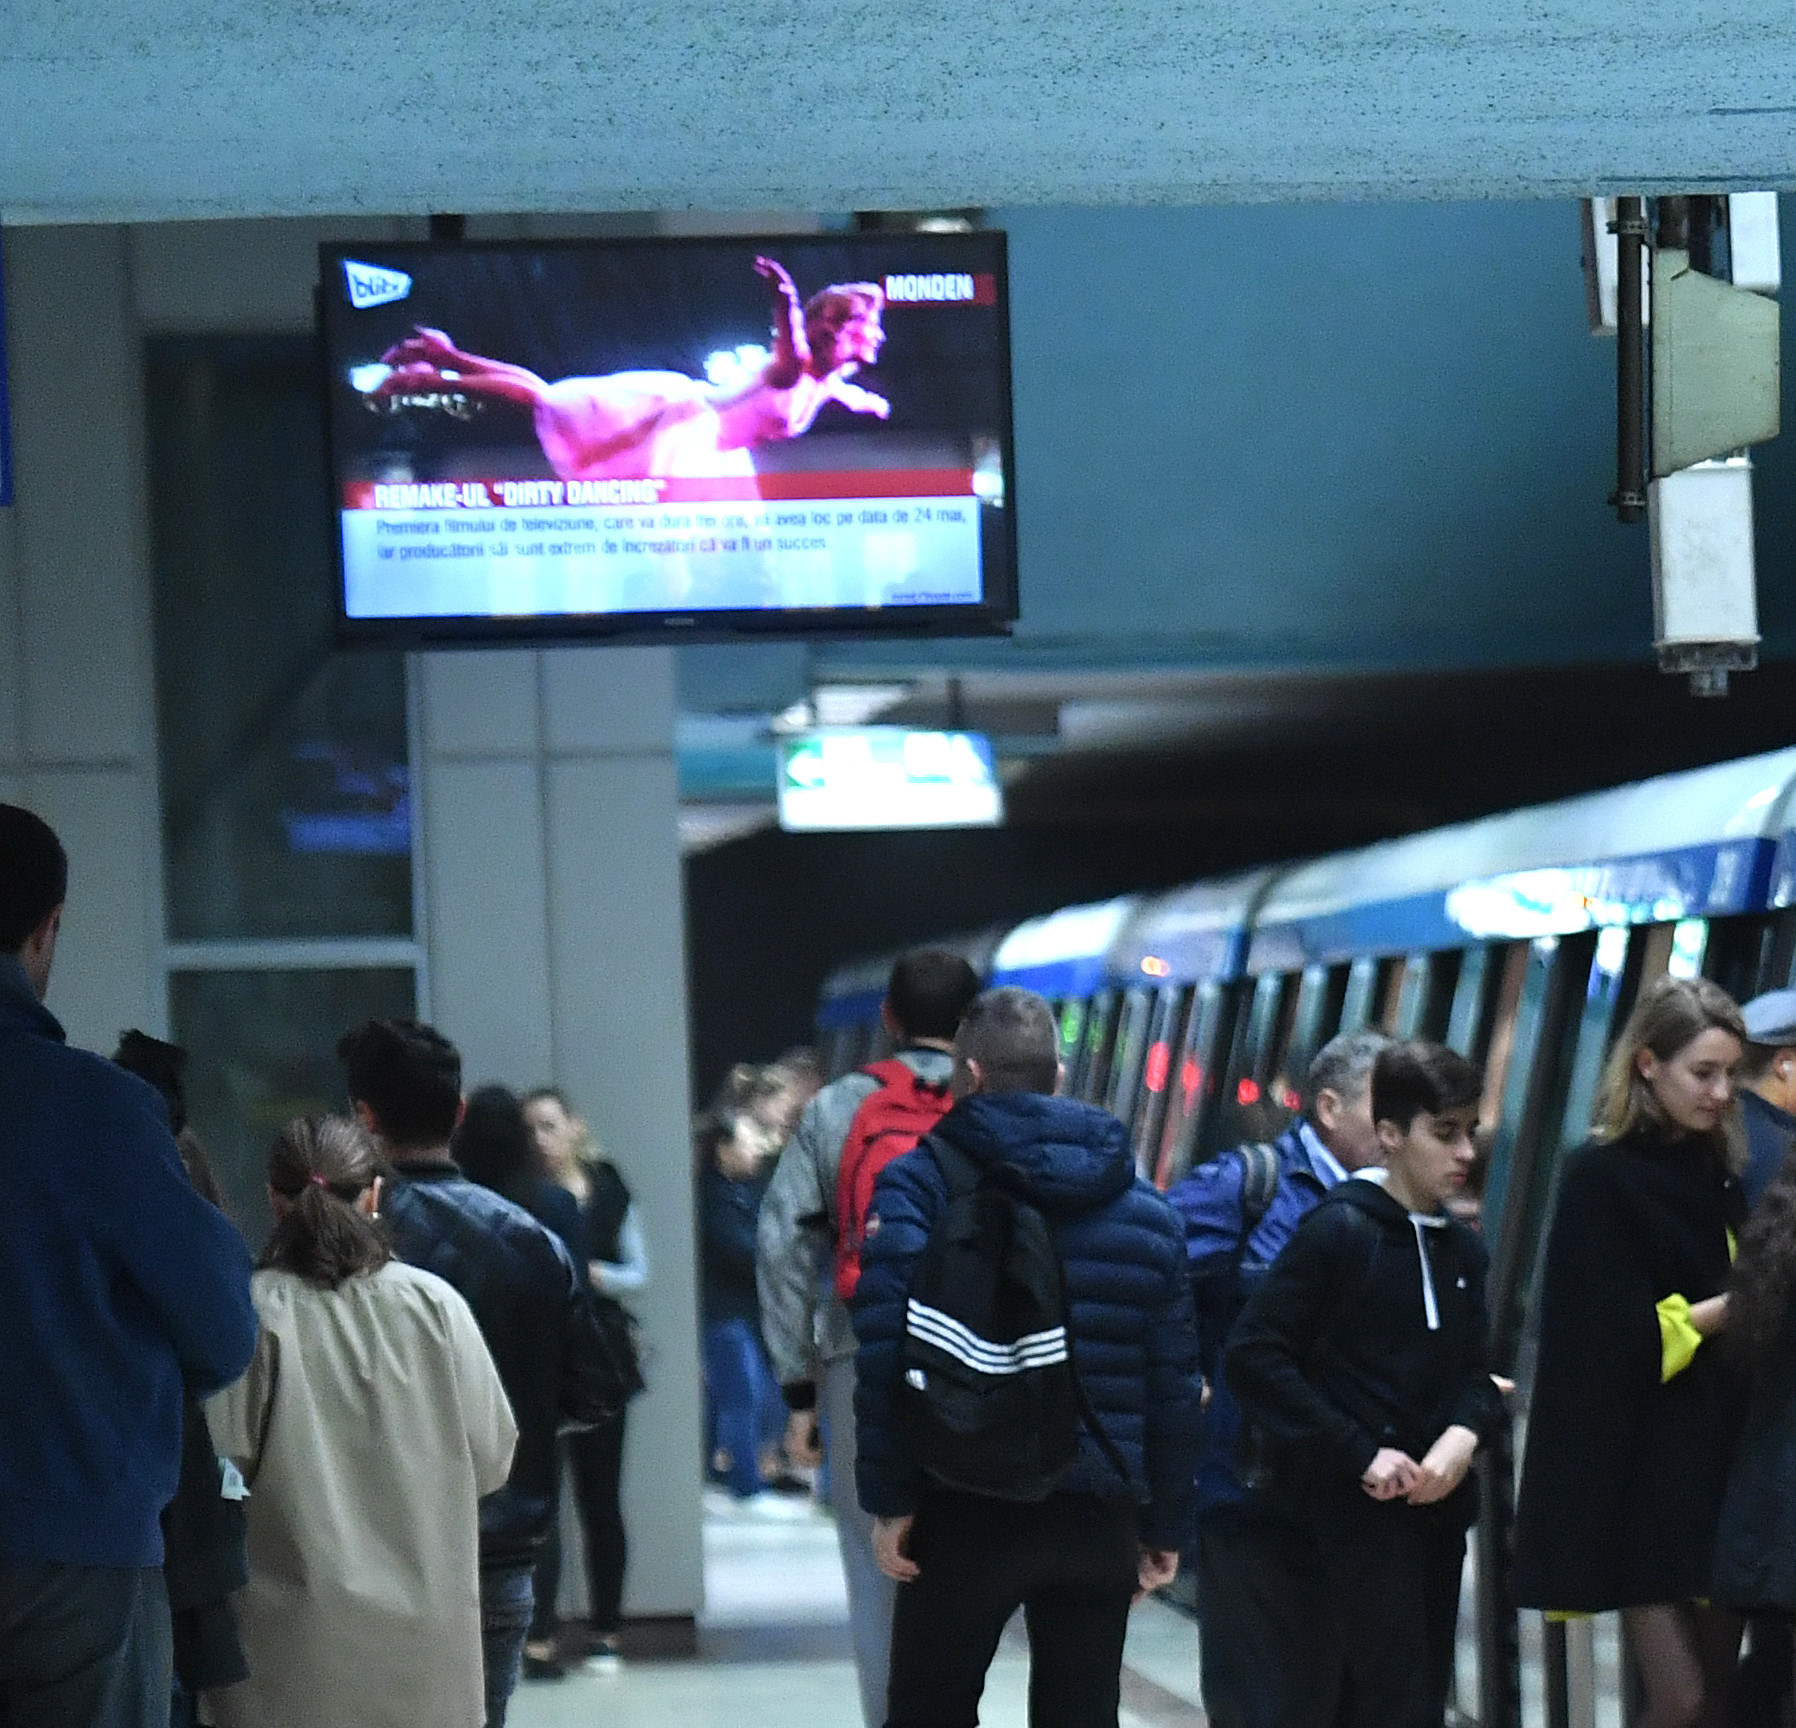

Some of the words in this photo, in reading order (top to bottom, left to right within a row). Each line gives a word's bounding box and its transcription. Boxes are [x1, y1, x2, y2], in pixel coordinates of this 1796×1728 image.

[885, 273, 975, 302] MONDEN
[373, 482, 491, 509] REMAKE-UL
[492, 480, 564, 507] "DIRTY
[566, 478, 666, 505] DANCING"
[375, 517, 440, 535] Premiera
[499, 517, 517, 532] de
[603, 516, 634, 531] care
[638, 515, 655, 529] va
[811, 509, 831, 527] loc
[836, 510, 853, 528] pe
[857, 508, 888, 525] data
[892, 507, 910, 524] de
[914, 506, 931, 524] 24
[514, 541, 544, 557] sunt
[547, 540, 596, 556] extrem
[601, 538, 618, 554] de
[754, 538, 772, 551] un
